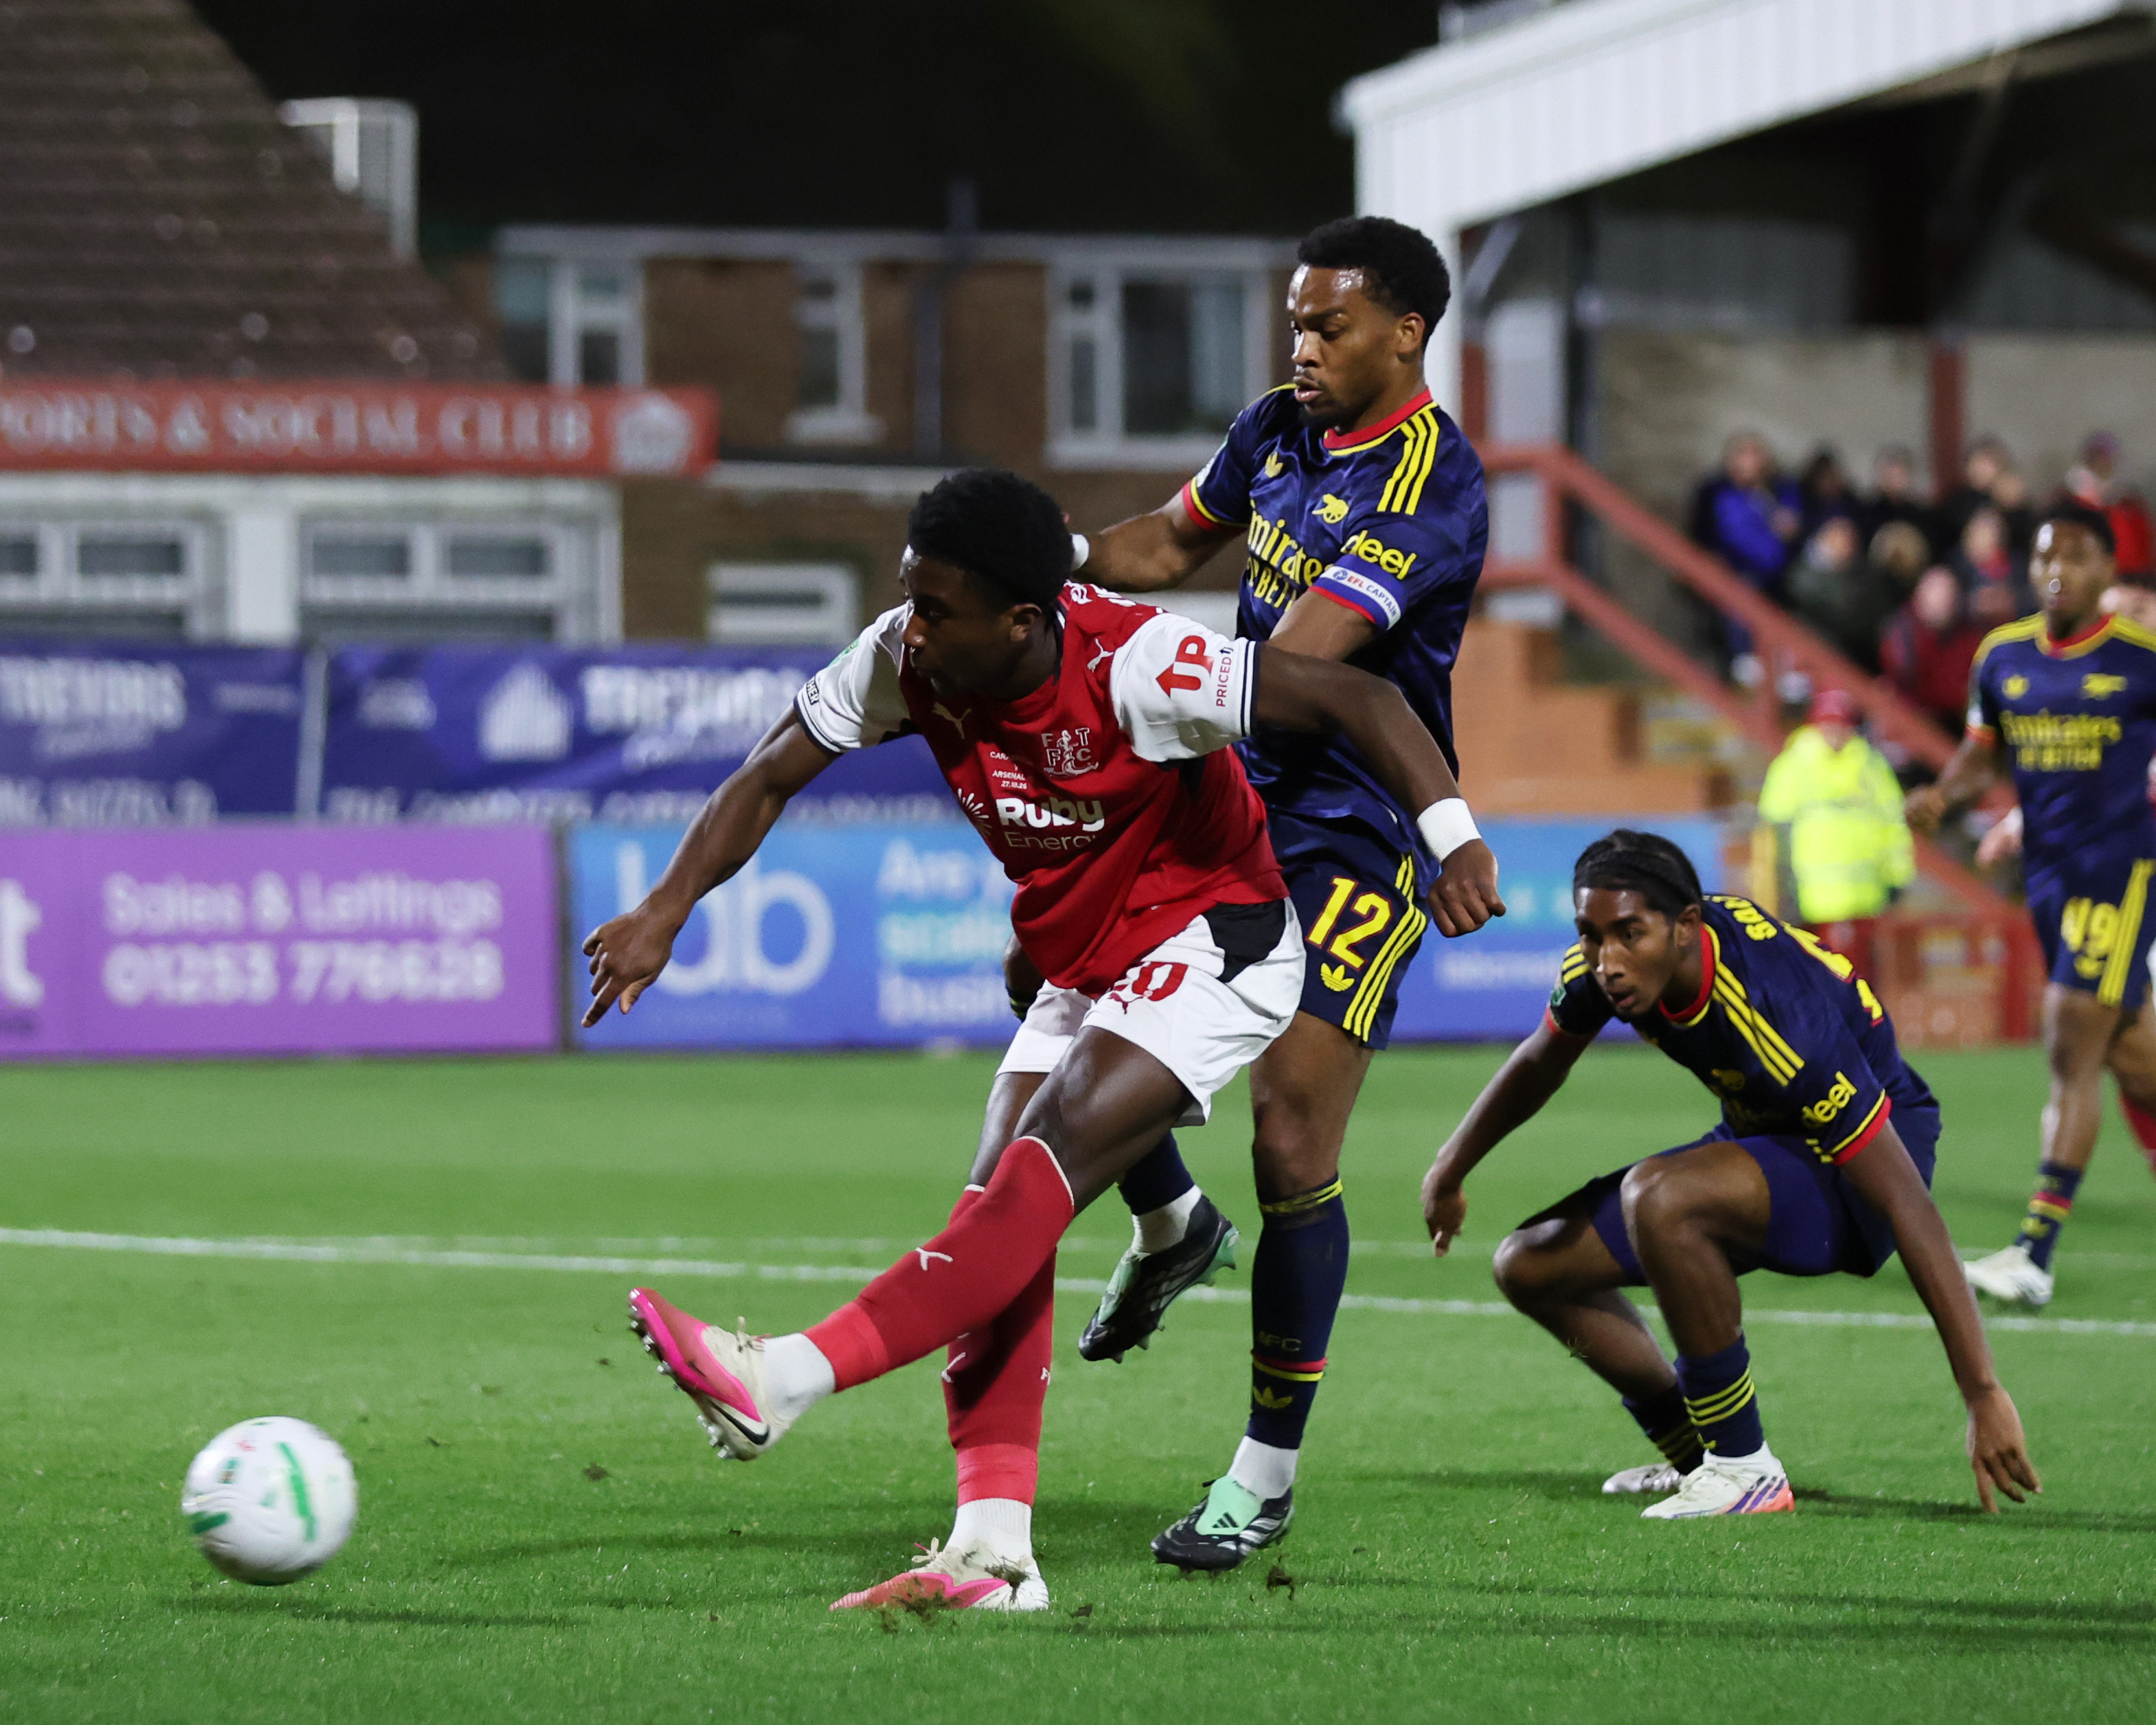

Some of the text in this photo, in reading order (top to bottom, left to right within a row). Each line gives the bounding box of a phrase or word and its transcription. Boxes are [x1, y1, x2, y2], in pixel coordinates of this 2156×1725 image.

[443, 398, 588, 456] CLUB
[1340, 529, 1417, 580] deel
[1347, 575, 1397, 617] EFL CAPTAIN
[1215, 656, 1232, 707] PRICED
[992, 769, 1026, 781] ARSENAL
[996, 797, 1105, 832] Ruby
[106, 873, 501, 939] Sales & Lettings
[1306, 876, 1392, 971] 12
[105, 946, 277, 1003] 01253
